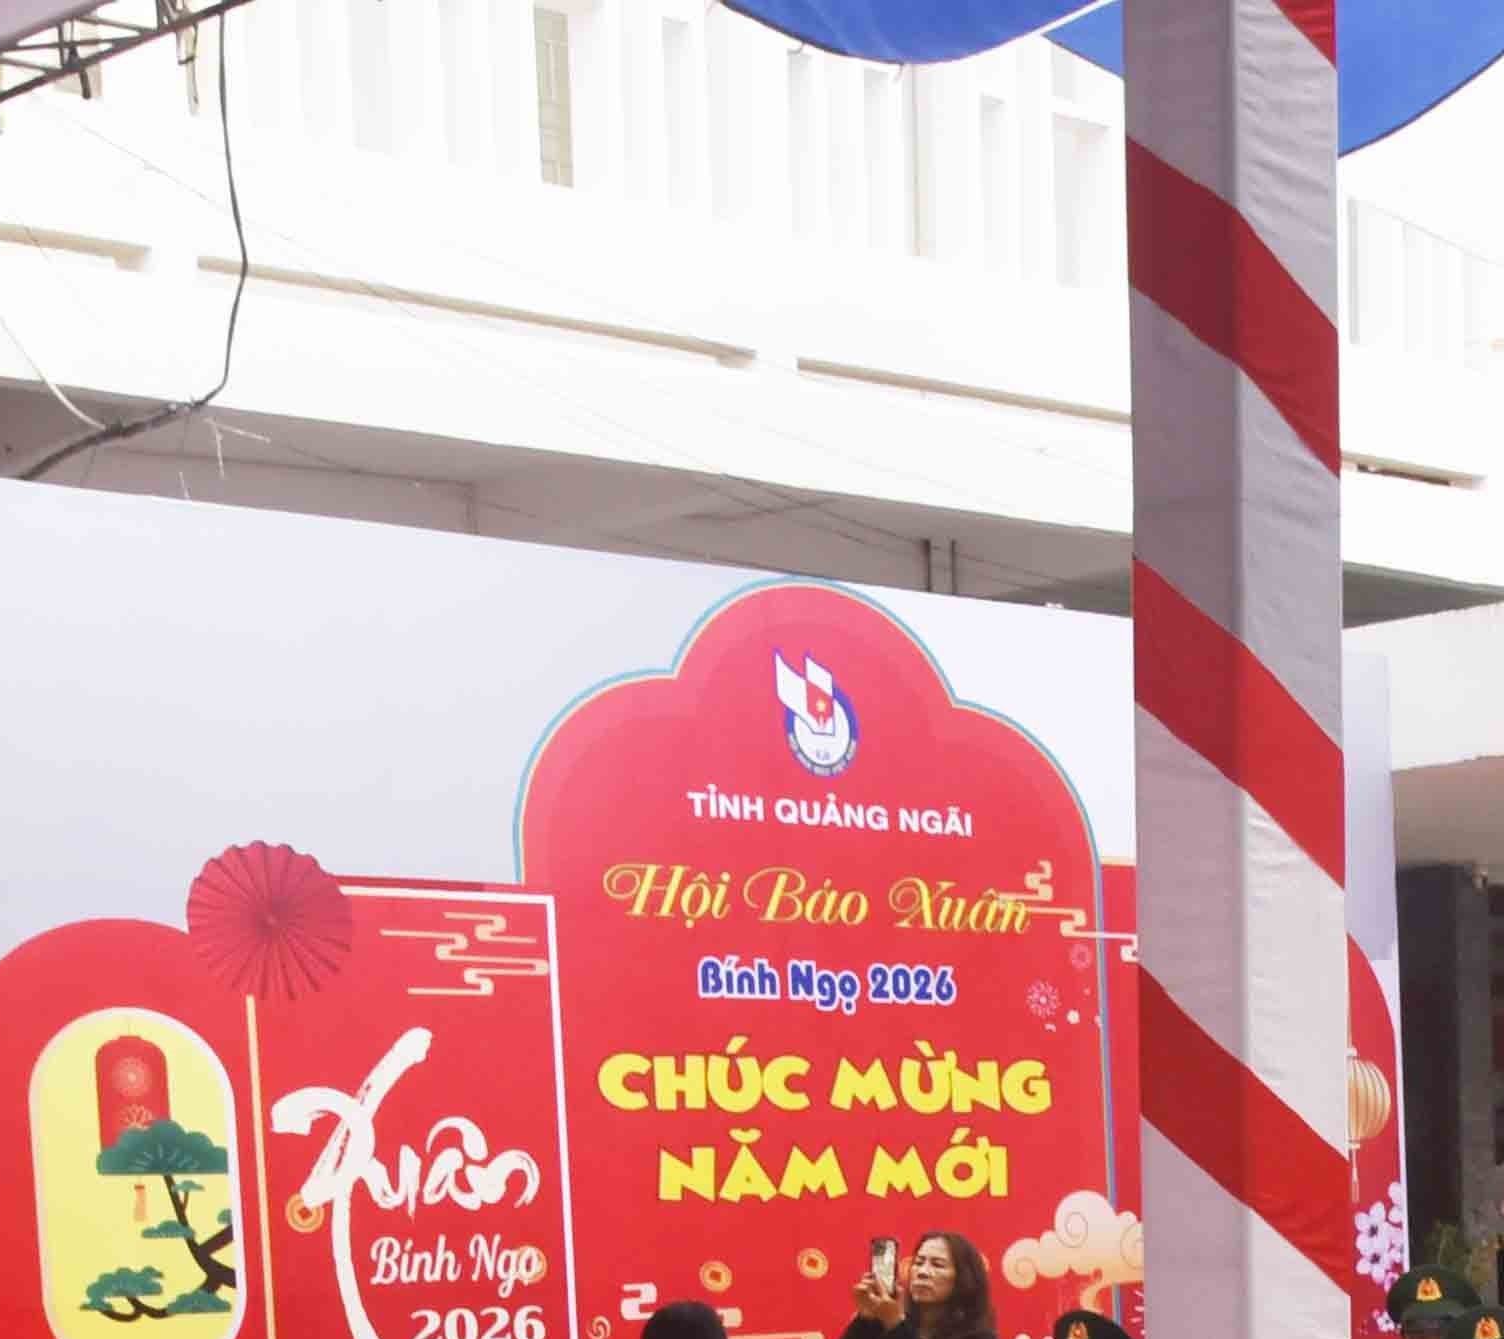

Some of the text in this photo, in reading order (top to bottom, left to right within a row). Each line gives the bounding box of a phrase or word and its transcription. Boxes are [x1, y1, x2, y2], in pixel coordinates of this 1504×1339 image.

[687, 784, 974, 837] TỈNH QUẢNG NGÃI
[602, 863, 1031, 935] Hội Báo Xuân
[698, 955, 958, 1015] Bính Ngọ 2026
[597, 1035, 1053, 1115] CHÚC MỪNG
[658, 1127, 1009, 1202] NĂM MỚI
